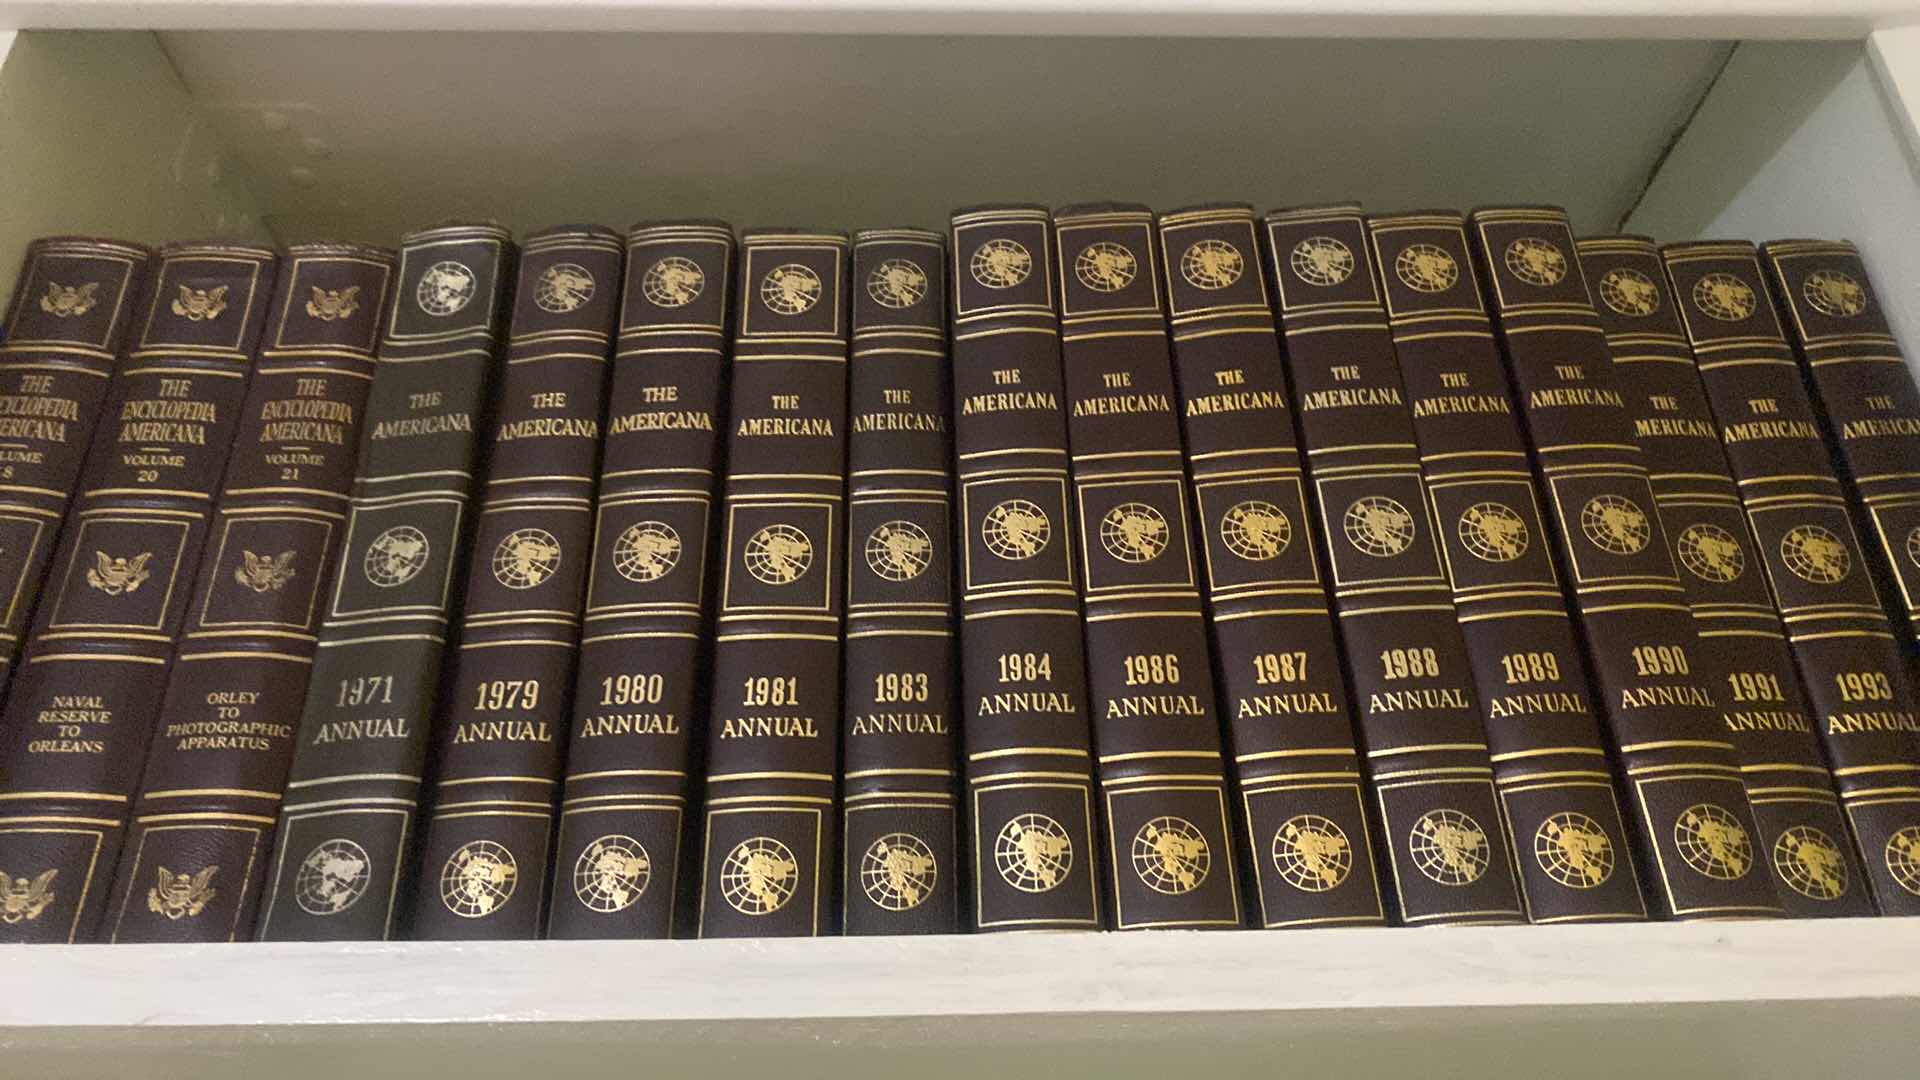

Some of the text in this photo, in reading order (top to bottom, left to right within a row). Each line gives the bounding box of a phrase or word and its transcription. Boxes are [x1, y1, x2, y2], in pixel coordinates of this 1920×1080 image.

[992, 369, 1021, 385] THE
[1103, 372, 1131, 388] THE
[1214, 370, 1244, 386] THE
[1330, 366, 1360, 381] THE
[1440, 372, 1470, 388] THE
[1555, 366, 1585, 380] THE
[20, 375, 55, 394] THE
[159, 379, 192, 397] THE
[295, 378, 328, 397] THE
[642, 386, 679, 403] THE
[408, 392, 442, 409] THE
[530, 392, 567, 408] THE
[771, 395, 799, 409] THE
[883, 389, 911, 404] THE
[962, 392, 1058, 416] AMERICANA
[1073, 394, 1170, 417] AMERICANA
[1185, 391, 1285, 417] AMERICANA
[1303, 387, 1402, 411] AMERICANA
[1413, 396, 1510, 418] AMERICANA
[1530, 388, 1624, 408] AMERICANA
[1648, 396, 1679, 410] THE
[1748, 399, 1779, 414] THE
[1865, 395, 1896, 409] THE
[120, 400, 216, 424] ENCYCLOPEDIA
[260, 400, 353, 424] ENCYCLOPEDIA
[609, 410, 713, 435] AMERICANA
[853, 412, 946, 432] AMERICANA
[0, 417, 65, 442] ERICANA
[118, 422, 206, 445] AMERICANA
[259, 422, 344, 445] AMERICANA
[371, 413, 473, 440] AMERICANA
[496, 417, 597, 441] AMERICANA
[737, 418, 834, 437] AMERICANA
[1633, 418, 1716, 438] MERICANA
[1725, 420, 1818, 443] AMERICANA
[0, 451, 42, 463] LUME
[122, 455, 185, 467] VOLUME
[265, 454, 325, 466] VOLUME
[136, 470, 159, 482] 20
[280, 468, 300, 480] 21
[998, 653, 1052, 682] 1984
[1124, 654, 1179, 685] 1986
[1253, 651, 1308, 684] 1987
[1380, 647, 1440, 680] 1988
[1501, 652, 1560, 684] 1989
[1632, 645, 1689, 676] 1990
[337, 676, 393, 707] 1971
[474, 680, 540, 710] 1979
[600, 674, 664, 706] 1980
[743, 676, 799, 706] 1981
[875, 673, 929, 703] 1983
[1622, 686, 1716, 709] ANNUAL
[1728, 672, 1785, 701] 1991
[1835, 672, 1893, 701] 1993
[52, 696, 104, 709] NAVAL
[207, 692, 260, 705] ORLEY
[979, 692, 1076, 716] ANNUAL
[1106, 695, 1205, 719] ANNUAL
[1238, 692, 1338, 719] ANNUAL
[1369, 688, 1469, 714] ANNUAL
[1489, 692, 1587, 719] ANNUAL
[37, 711, 112, 723] RESERVE
[218, 707, 240, 719] TO
[853, 713, 948, 735] ANNUAL
[1828, 712, 1920, 735] ANNUAL
[57, 725, 81, 737] TO
[166, 721, 292, 738] PHOTOGRAPHIC
[314, 717, 410, 745] ANNUAL
[454, 720, 552, 744] ANNUAL
[581, 714, 679, 738] ANNUAL
[720, 717, 818, 739] ANNUAL
[28, 740, 104, 753] ORLEANS
[176, 736, 270, 750] APPARATUS
